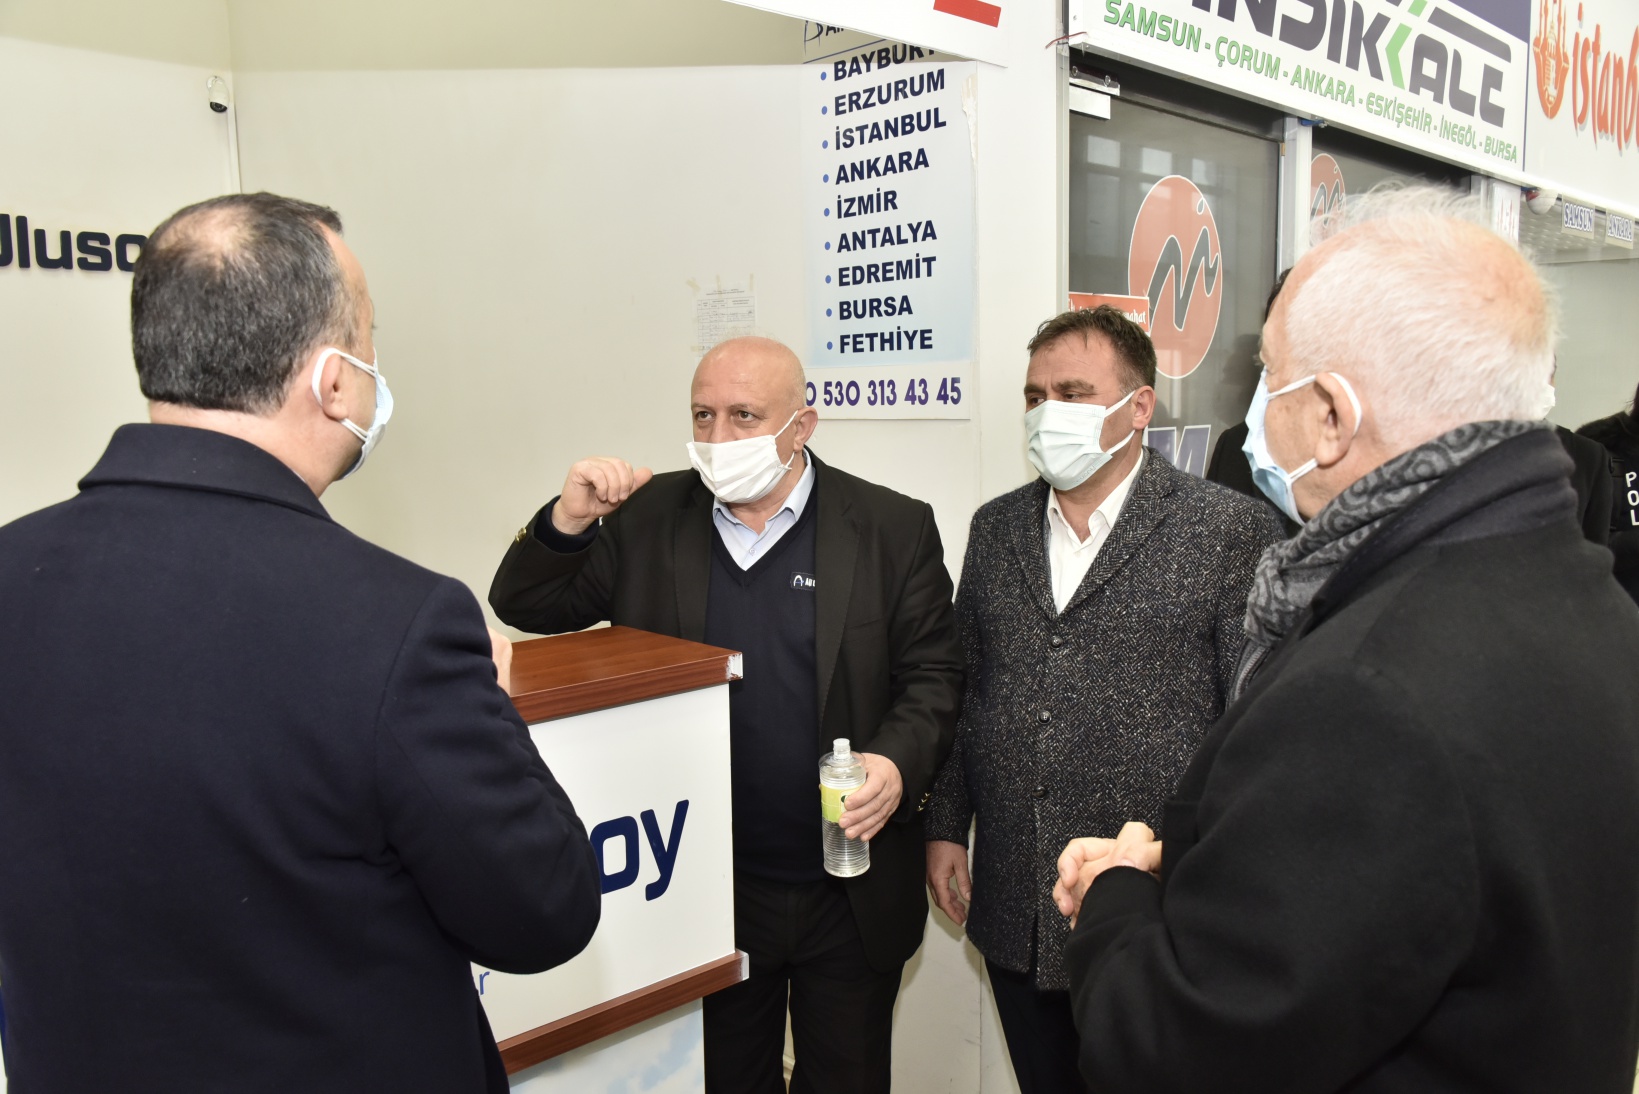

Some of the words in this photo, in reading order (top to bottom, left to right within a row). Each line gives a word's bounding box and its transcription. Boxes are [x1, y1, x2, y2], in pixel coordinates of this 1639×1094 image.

[834, 43, 935, 81] BAYBUR
[1571, 2, 1639, 151] istanb
[835, 68, 945, 116] ERZURUM
[1103, 0, 1202, 53] SAMSUN
[1215, 36, 1281, 80] ÇORUM
[1290, 65, 1355, 107] ANKARA
[1366, 91, 1433, 135] ESKİŞEHİR
[1439, 114, 1477, 150] İNEGÖL
[1483, 135, 1518, 164] BURSA
[835, 107, 947, 151] İSTANBUL
[835, 147, 930, 186] ANKARA
[837, 187, 898, 220] İZMİR
[0, 213, 148, 272] luso
[837, 220, 938, 254] ANTALYA
[838, 253, 937, 287] EDREMİT
[839, 295, 913, 321] BURSA
[840, 326, 933, 354] FETHİYE
[823, 380, 861, 407] 530
[867, 379, 897, 406] 313
[904, 378, 929, 406] 43
[936, 376, 962, 405] 45
